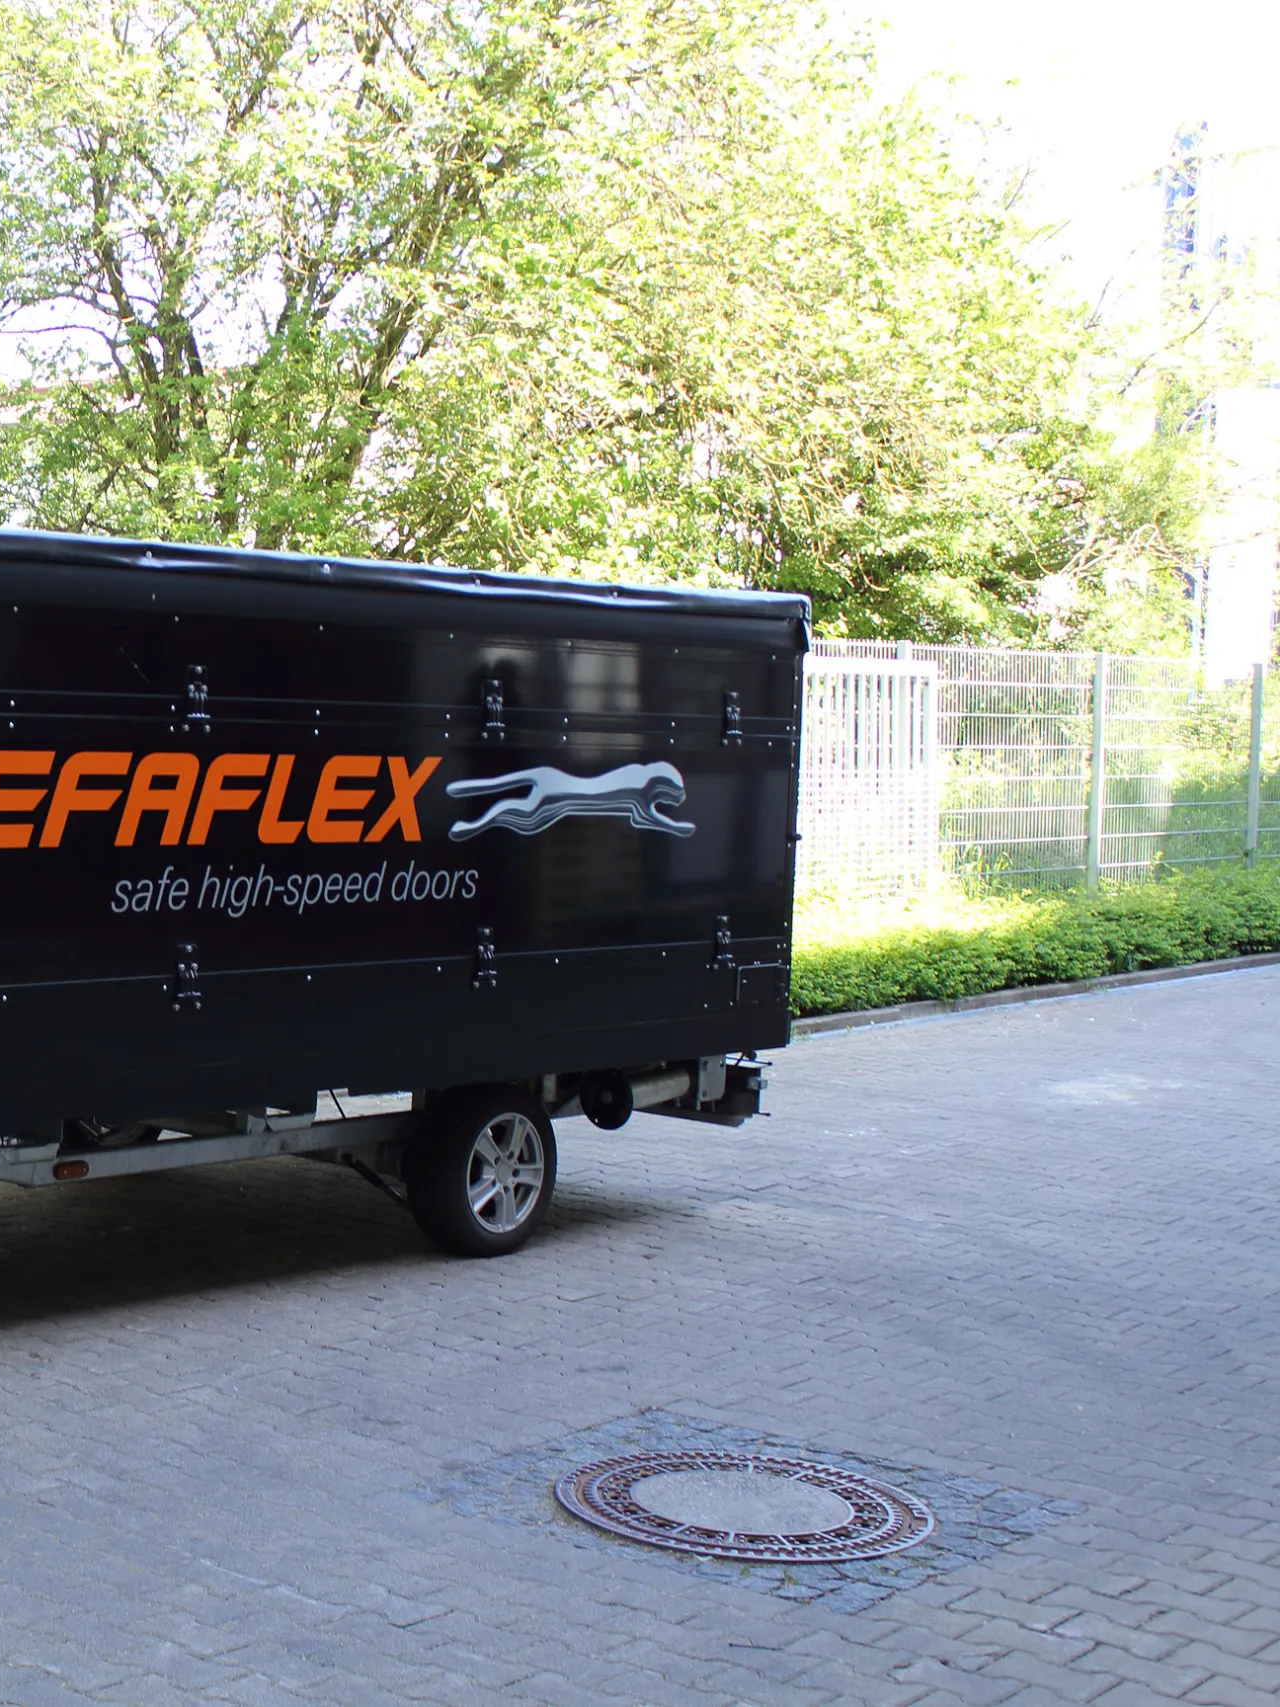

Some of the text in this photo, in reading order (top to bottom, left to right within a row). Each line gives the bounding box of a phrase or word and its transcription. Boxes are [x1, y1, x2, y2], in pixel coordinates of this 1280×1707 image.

[111, 860, 479, 918] safe high-speed doors
